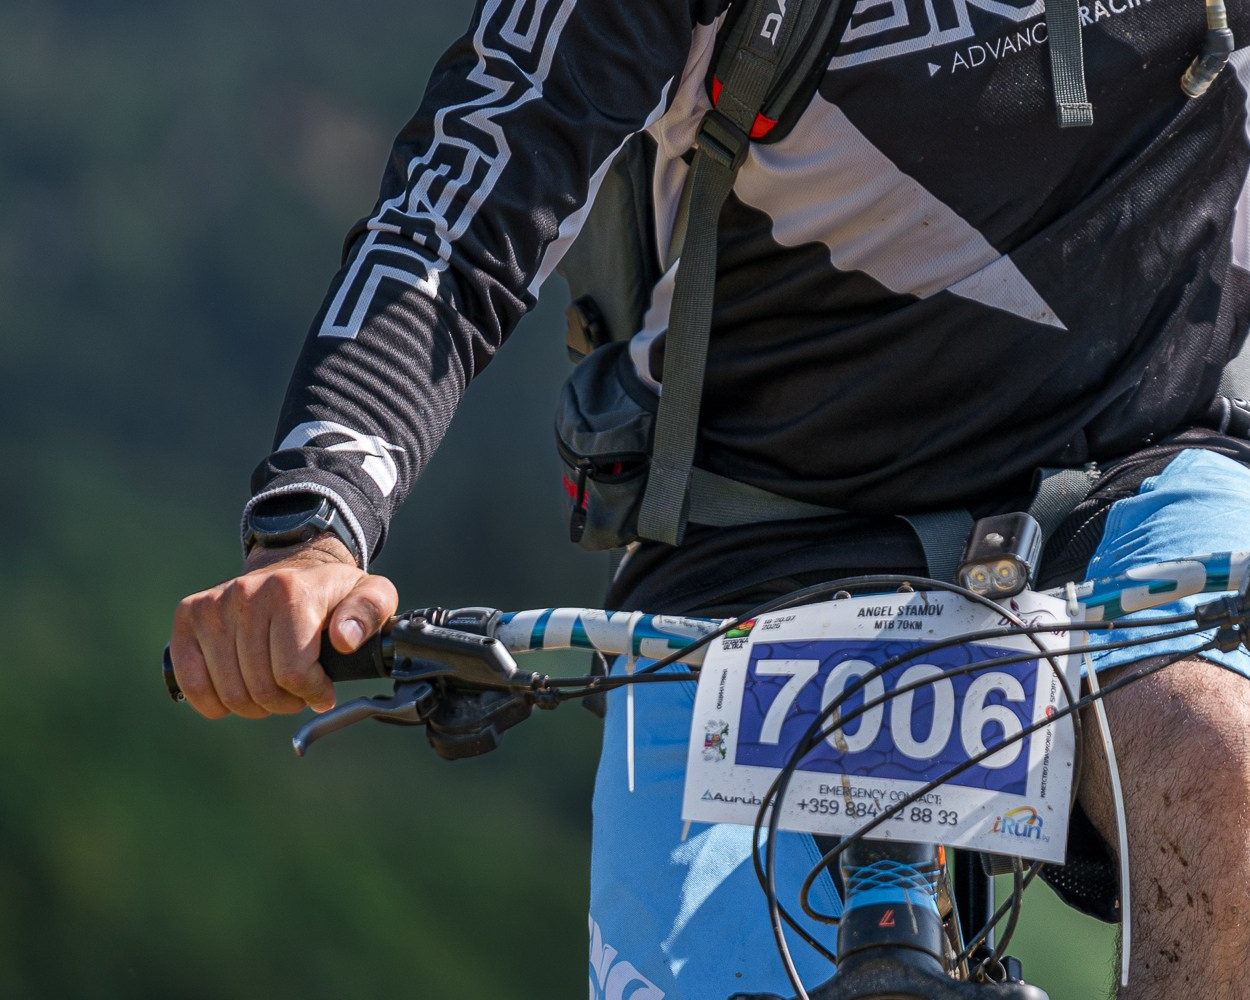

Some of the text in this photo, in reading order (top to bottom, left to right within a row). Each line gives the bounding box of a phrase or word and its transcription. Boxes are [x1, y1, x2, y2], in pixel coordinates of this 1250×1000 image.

[951, 22, 1048, 74] ADVANC
[857, 604, 944, 617] ANGEL STAMOV
[874, 620, 923, 630] MTB 70KM
[755, 658, 1027, 770] 7006
[713, 792, 776, 807] Aurubs
[819, 784, 942, 805] EMERGENCY COACT:
[797, 798, 840, 815] +359
[845, 802, 878, 818] 884
[910, 807, 932, 824] 88
[938, 810, 958, 826] 33
